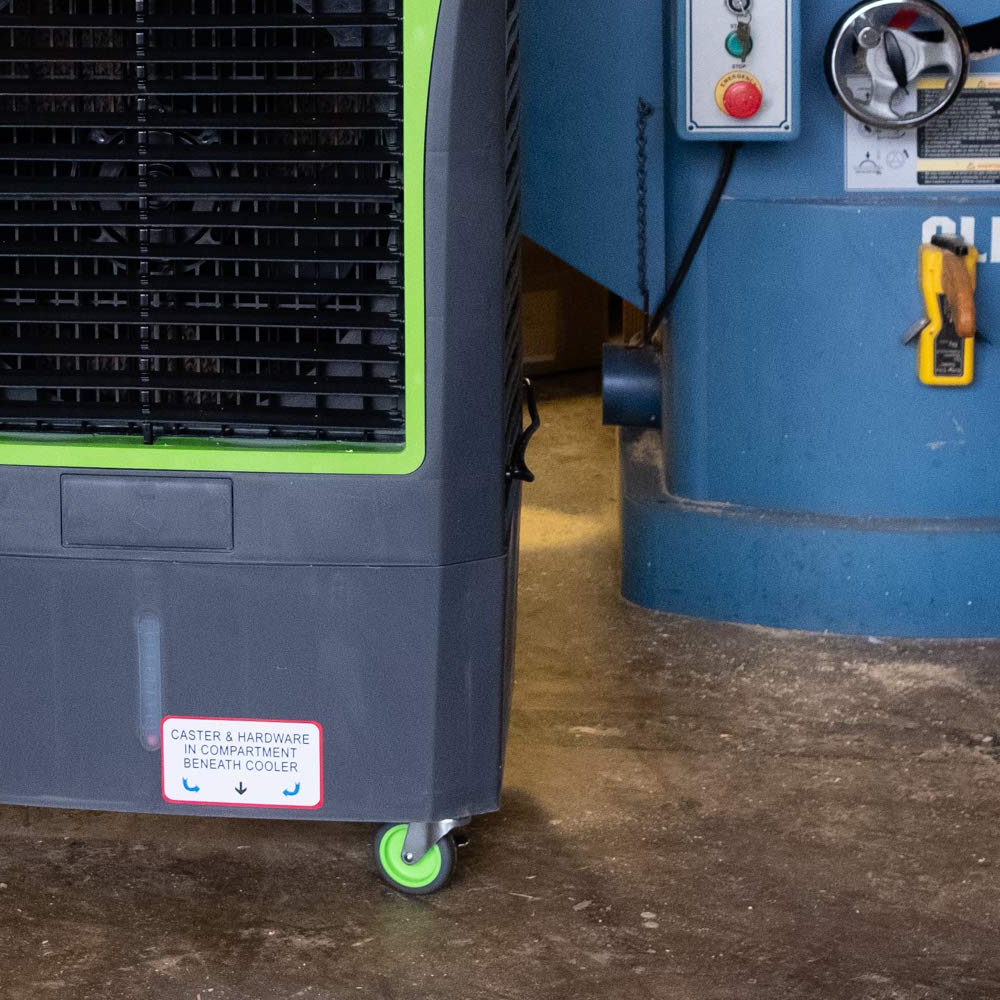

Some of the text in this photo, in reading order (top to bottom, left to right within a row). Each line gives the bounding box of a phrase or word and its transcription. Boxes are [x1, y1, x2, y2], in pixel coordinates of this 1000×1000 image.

[170, 728, 310, 745] CASTER & HARDWARE
[184, 744, 297, 758] IN COMPARTMENT
[183, 757, 298, 772] BENEATH COOLER
